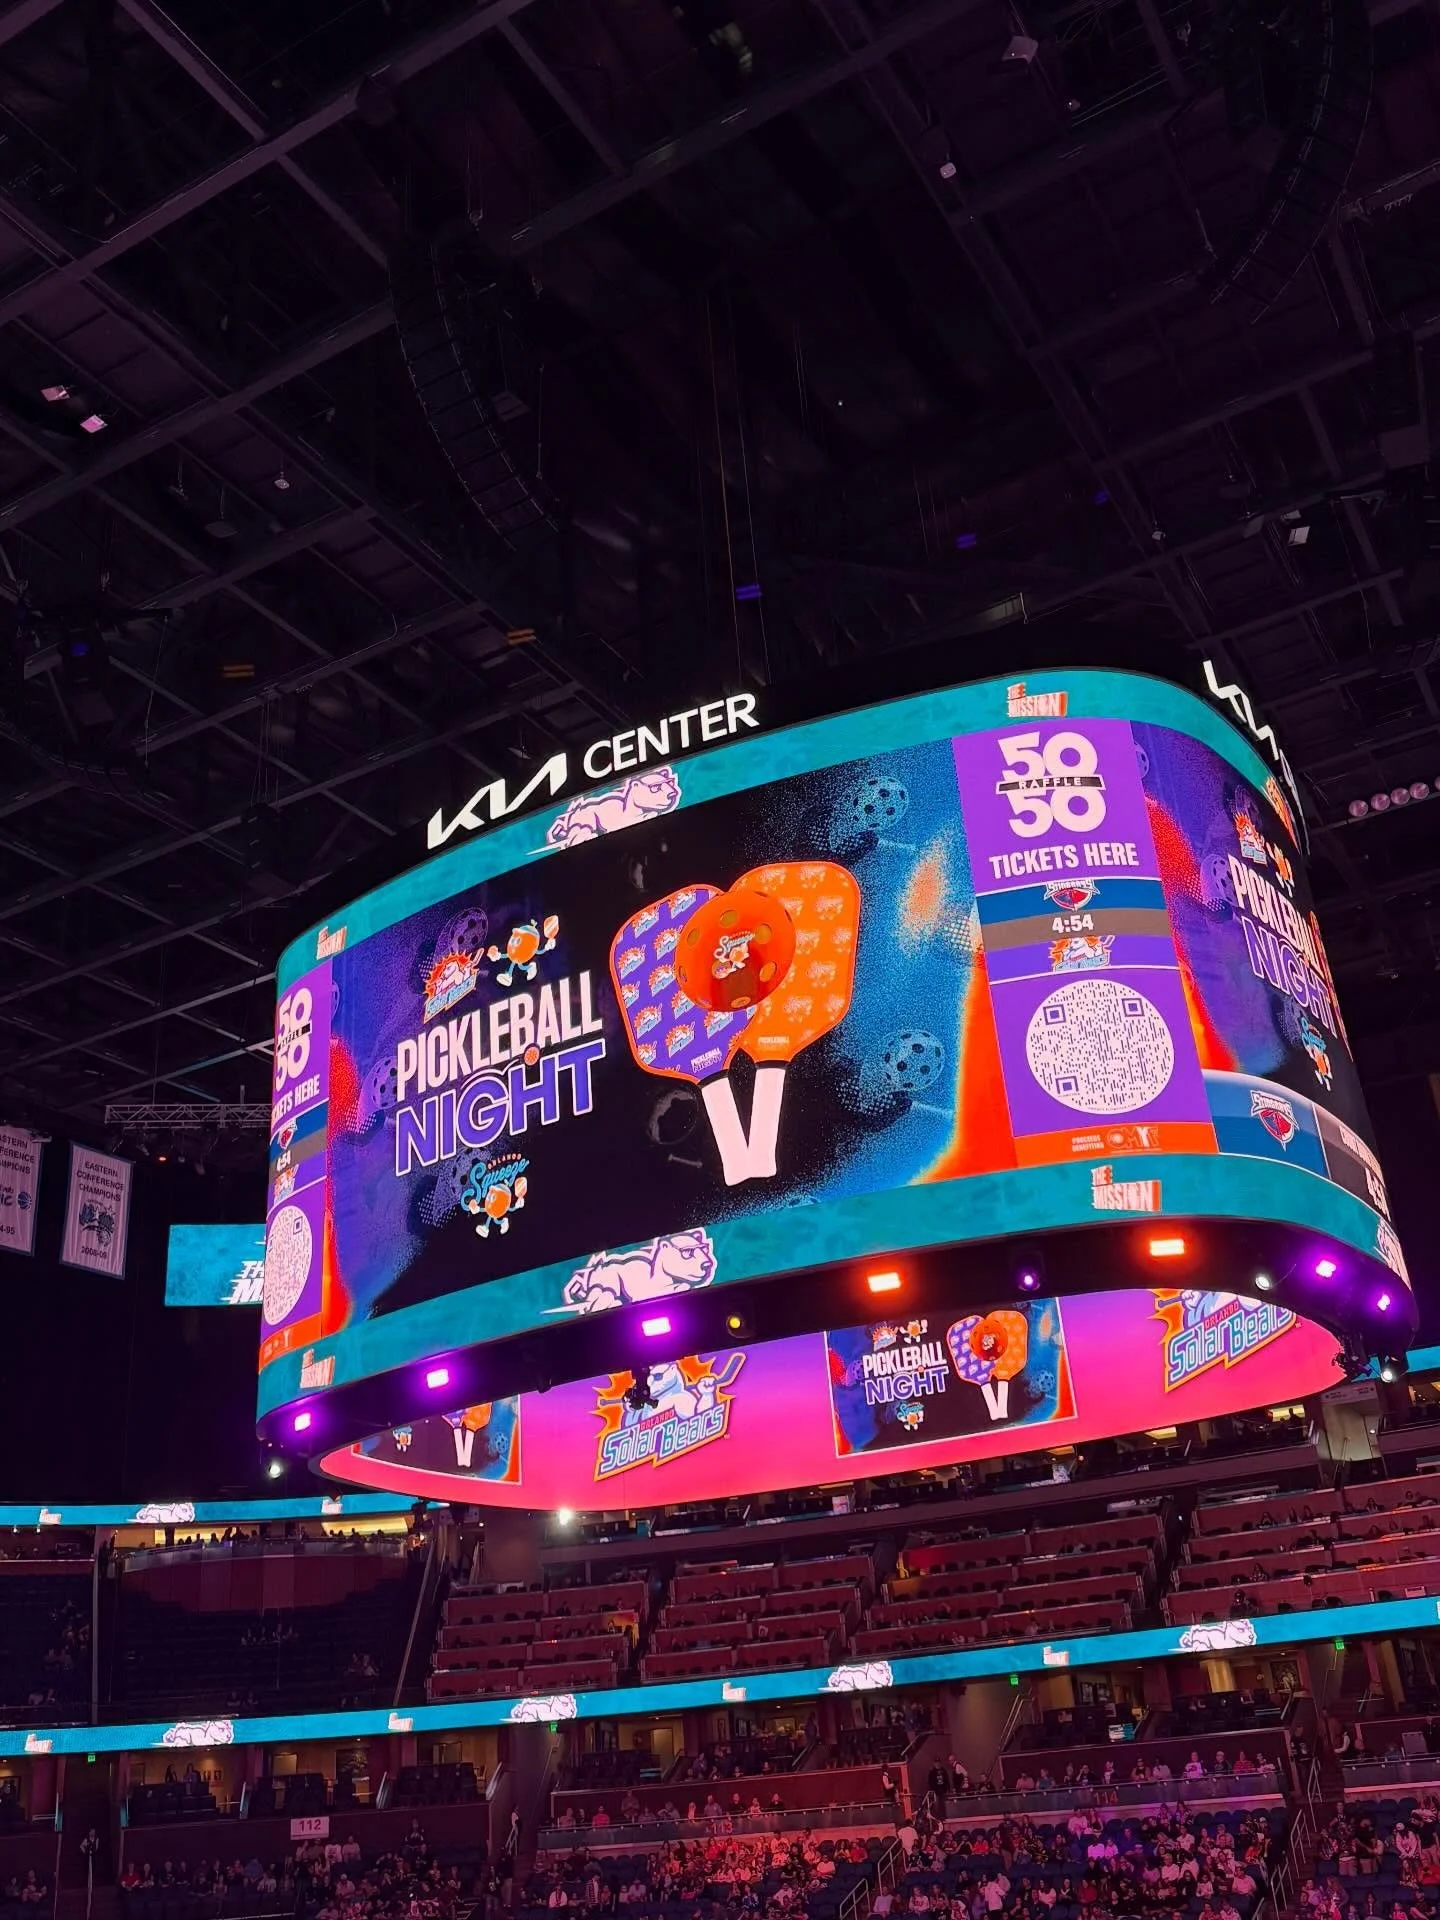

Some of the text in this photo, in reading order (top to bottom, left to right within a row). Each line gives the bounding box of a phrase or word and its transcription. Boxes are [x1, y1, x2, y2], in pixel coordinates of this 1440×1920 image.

[427, 691, 760, 850] KIA CENTER
[998, 731, 1098, 782] 50
[1018, 776, 1083, 791] RAFFLE
[1006, 787, 1107, 838] 50
[989, 842, 1139, 879] TICKETS HERE
[1052, 914, 1094, 933] 4:54
[1227, 854, 1324, 974] PICKLEBALL
[1241, 915, 1337, 1040] NIGHT
[397, 970, 603, 1102] PICKLEBALL
[294, 1074, 320, 1107] HERE
[396, 1038, 606, 1177] NIGHT
[76, 1170, 125, 1191] CONFERENCE
[85, 1161, 118, 1178] EASTERN
[460, 1158, 530, 1211] Squeeze
[79, 1183, 121, 1202] CHAMPIONS
[1204, 1300, 1240, 1330] ORLANDO
[863, 1341, 947, 1378] PICKLEBALL
[865, 1366, 950, 1406] NIGHT
[641, 1408, 676, 1431] ORLANDO
[299, 1819, 321, 1832] 112
